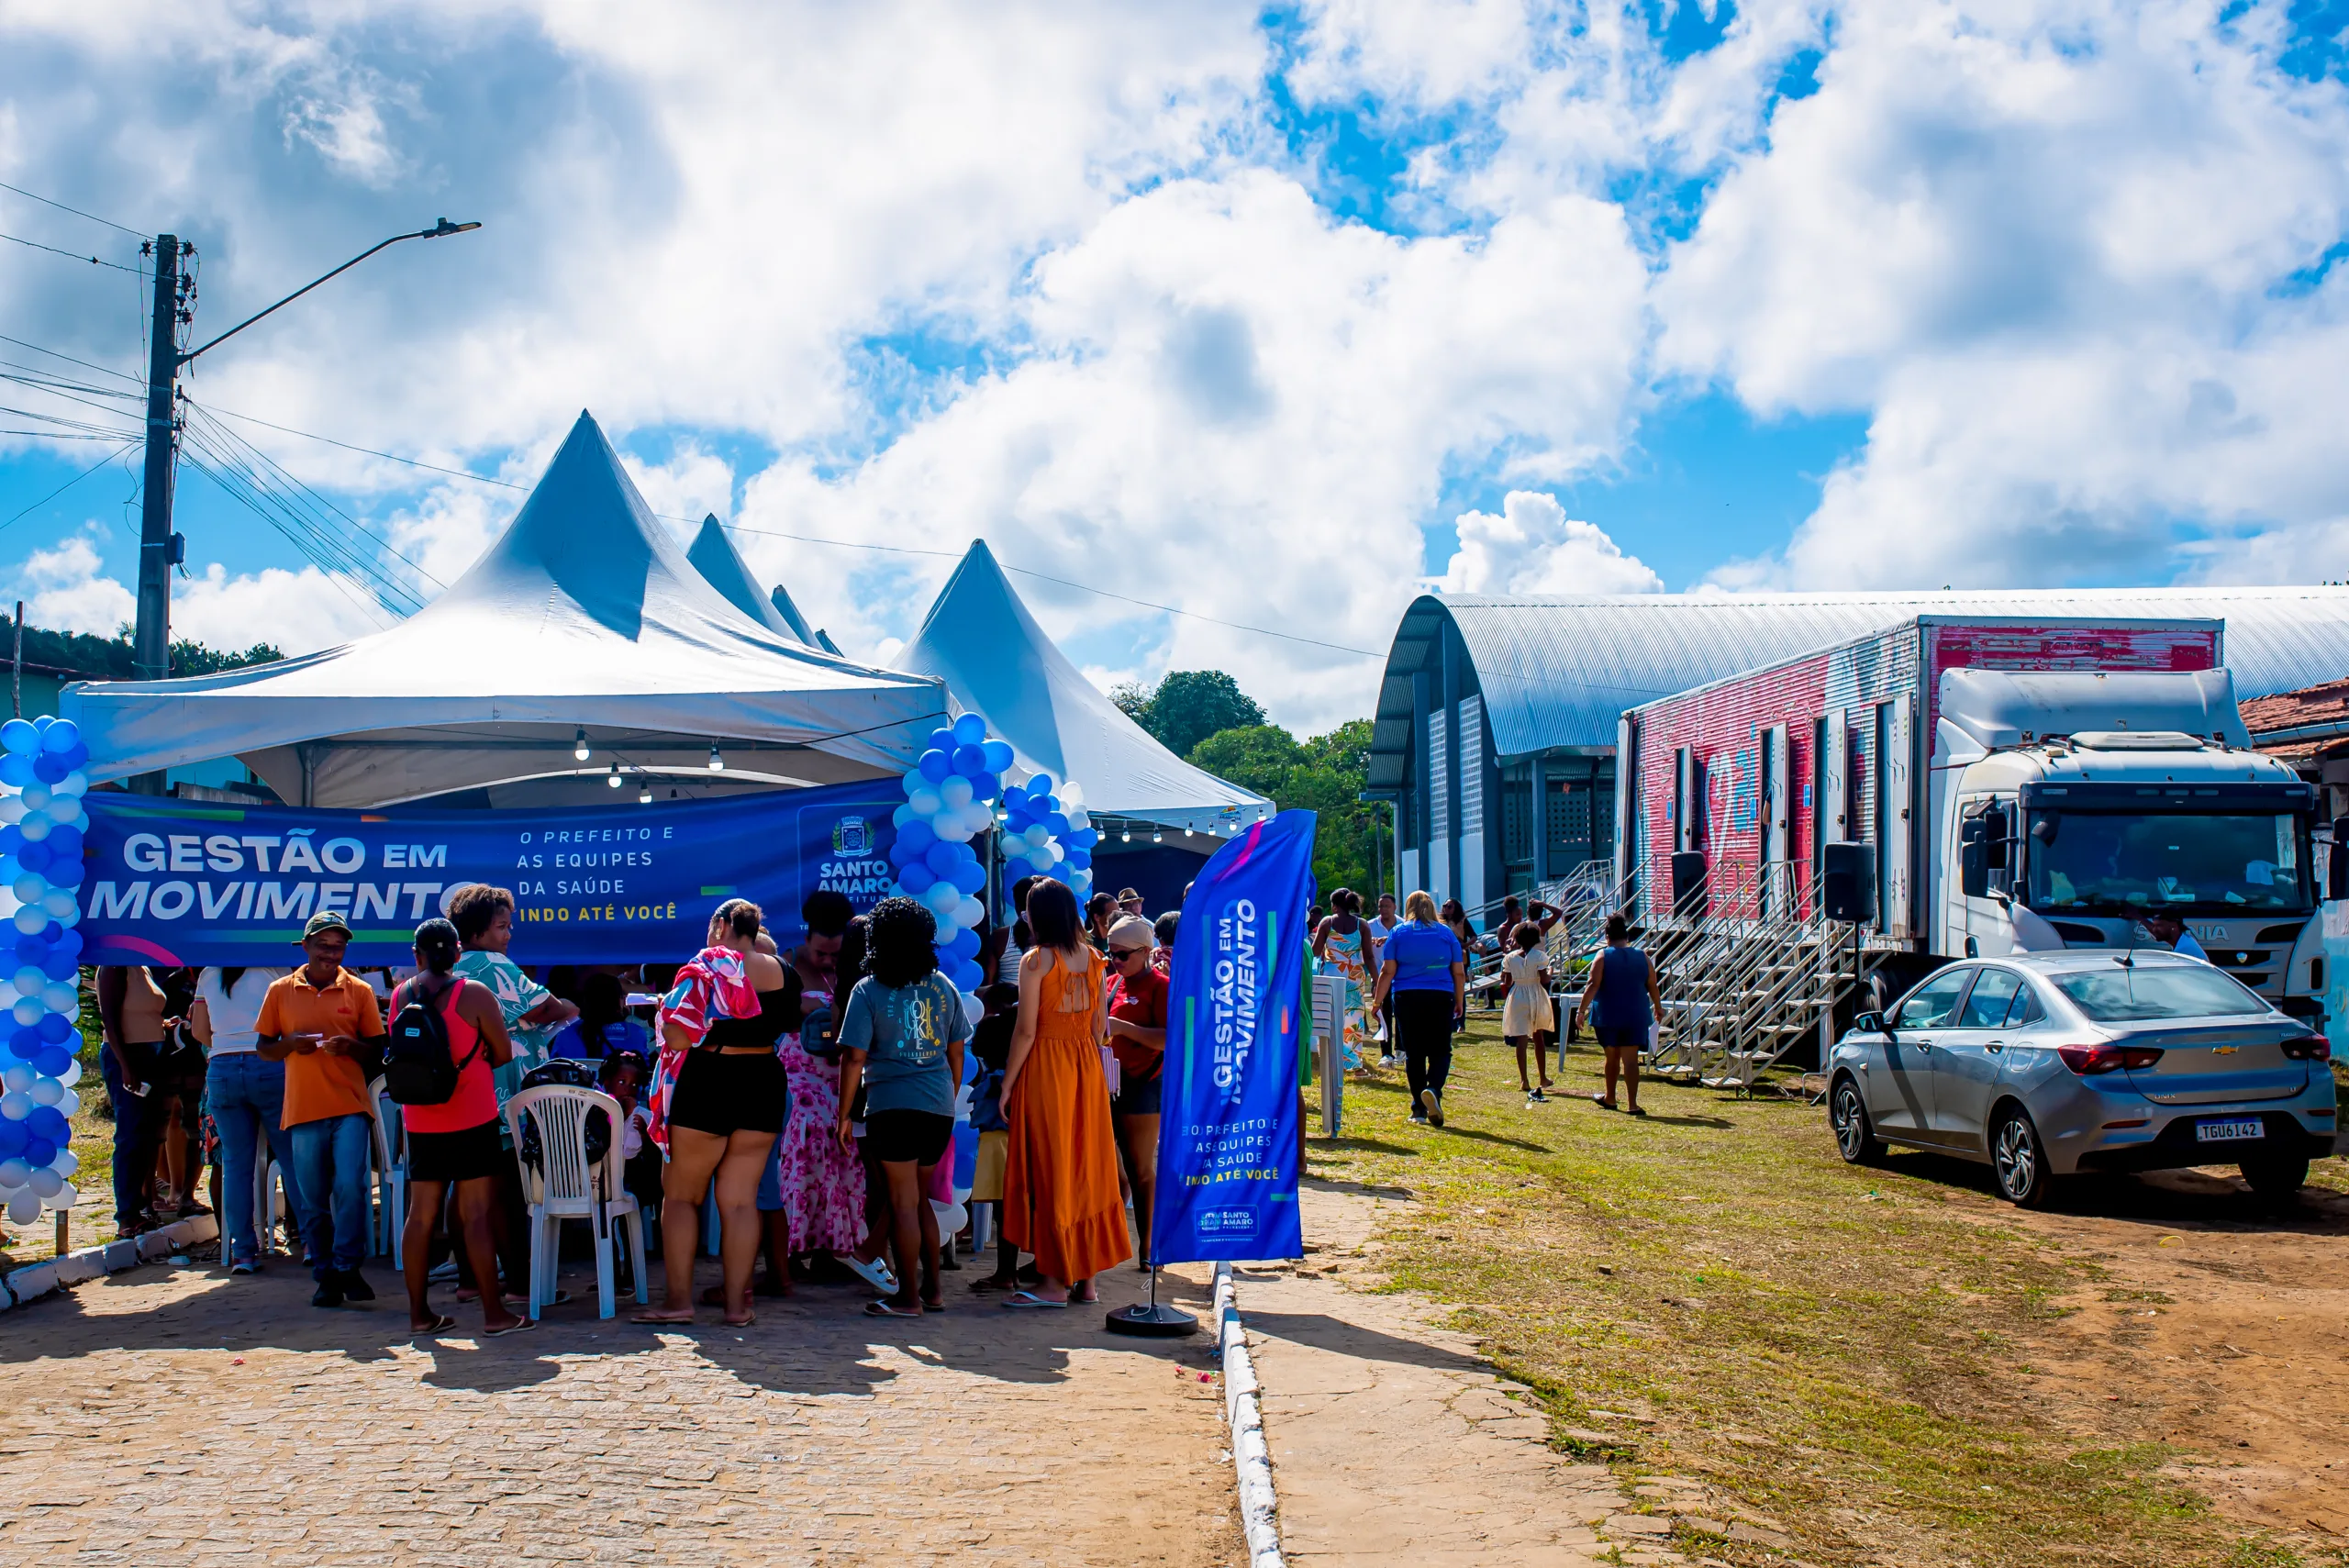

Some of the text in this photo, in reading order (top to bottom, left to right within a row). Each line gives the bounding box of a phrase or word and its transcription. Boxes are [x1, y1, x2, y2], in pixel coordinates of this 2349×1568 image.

[519, 827, 674, 844] O PREFEITO E
[123, 828, 447, 874] GESTÃO EM
[518, 851, 652, 869] AS EQUIPES
[820, 860, 888, 878] SANTO
[518, 877, 624, 895] DA SAÚDE
[818, 877, 894, 894] AMARO
[519, 901, 676, 922] INDO ATÉ VOCÊ
[2133, 925, 2230, 941] SNIA
[1209, 918, 1234, 1088] GESTÃO EM
[1195, 1142, 1211, 1153] AS
[1217, 1151, 1263, 1168] SAÚDE
[1215, 1168, 1241, 1184] ATÉ
[1246, 1167, 1279, 1181] VOCÊ
